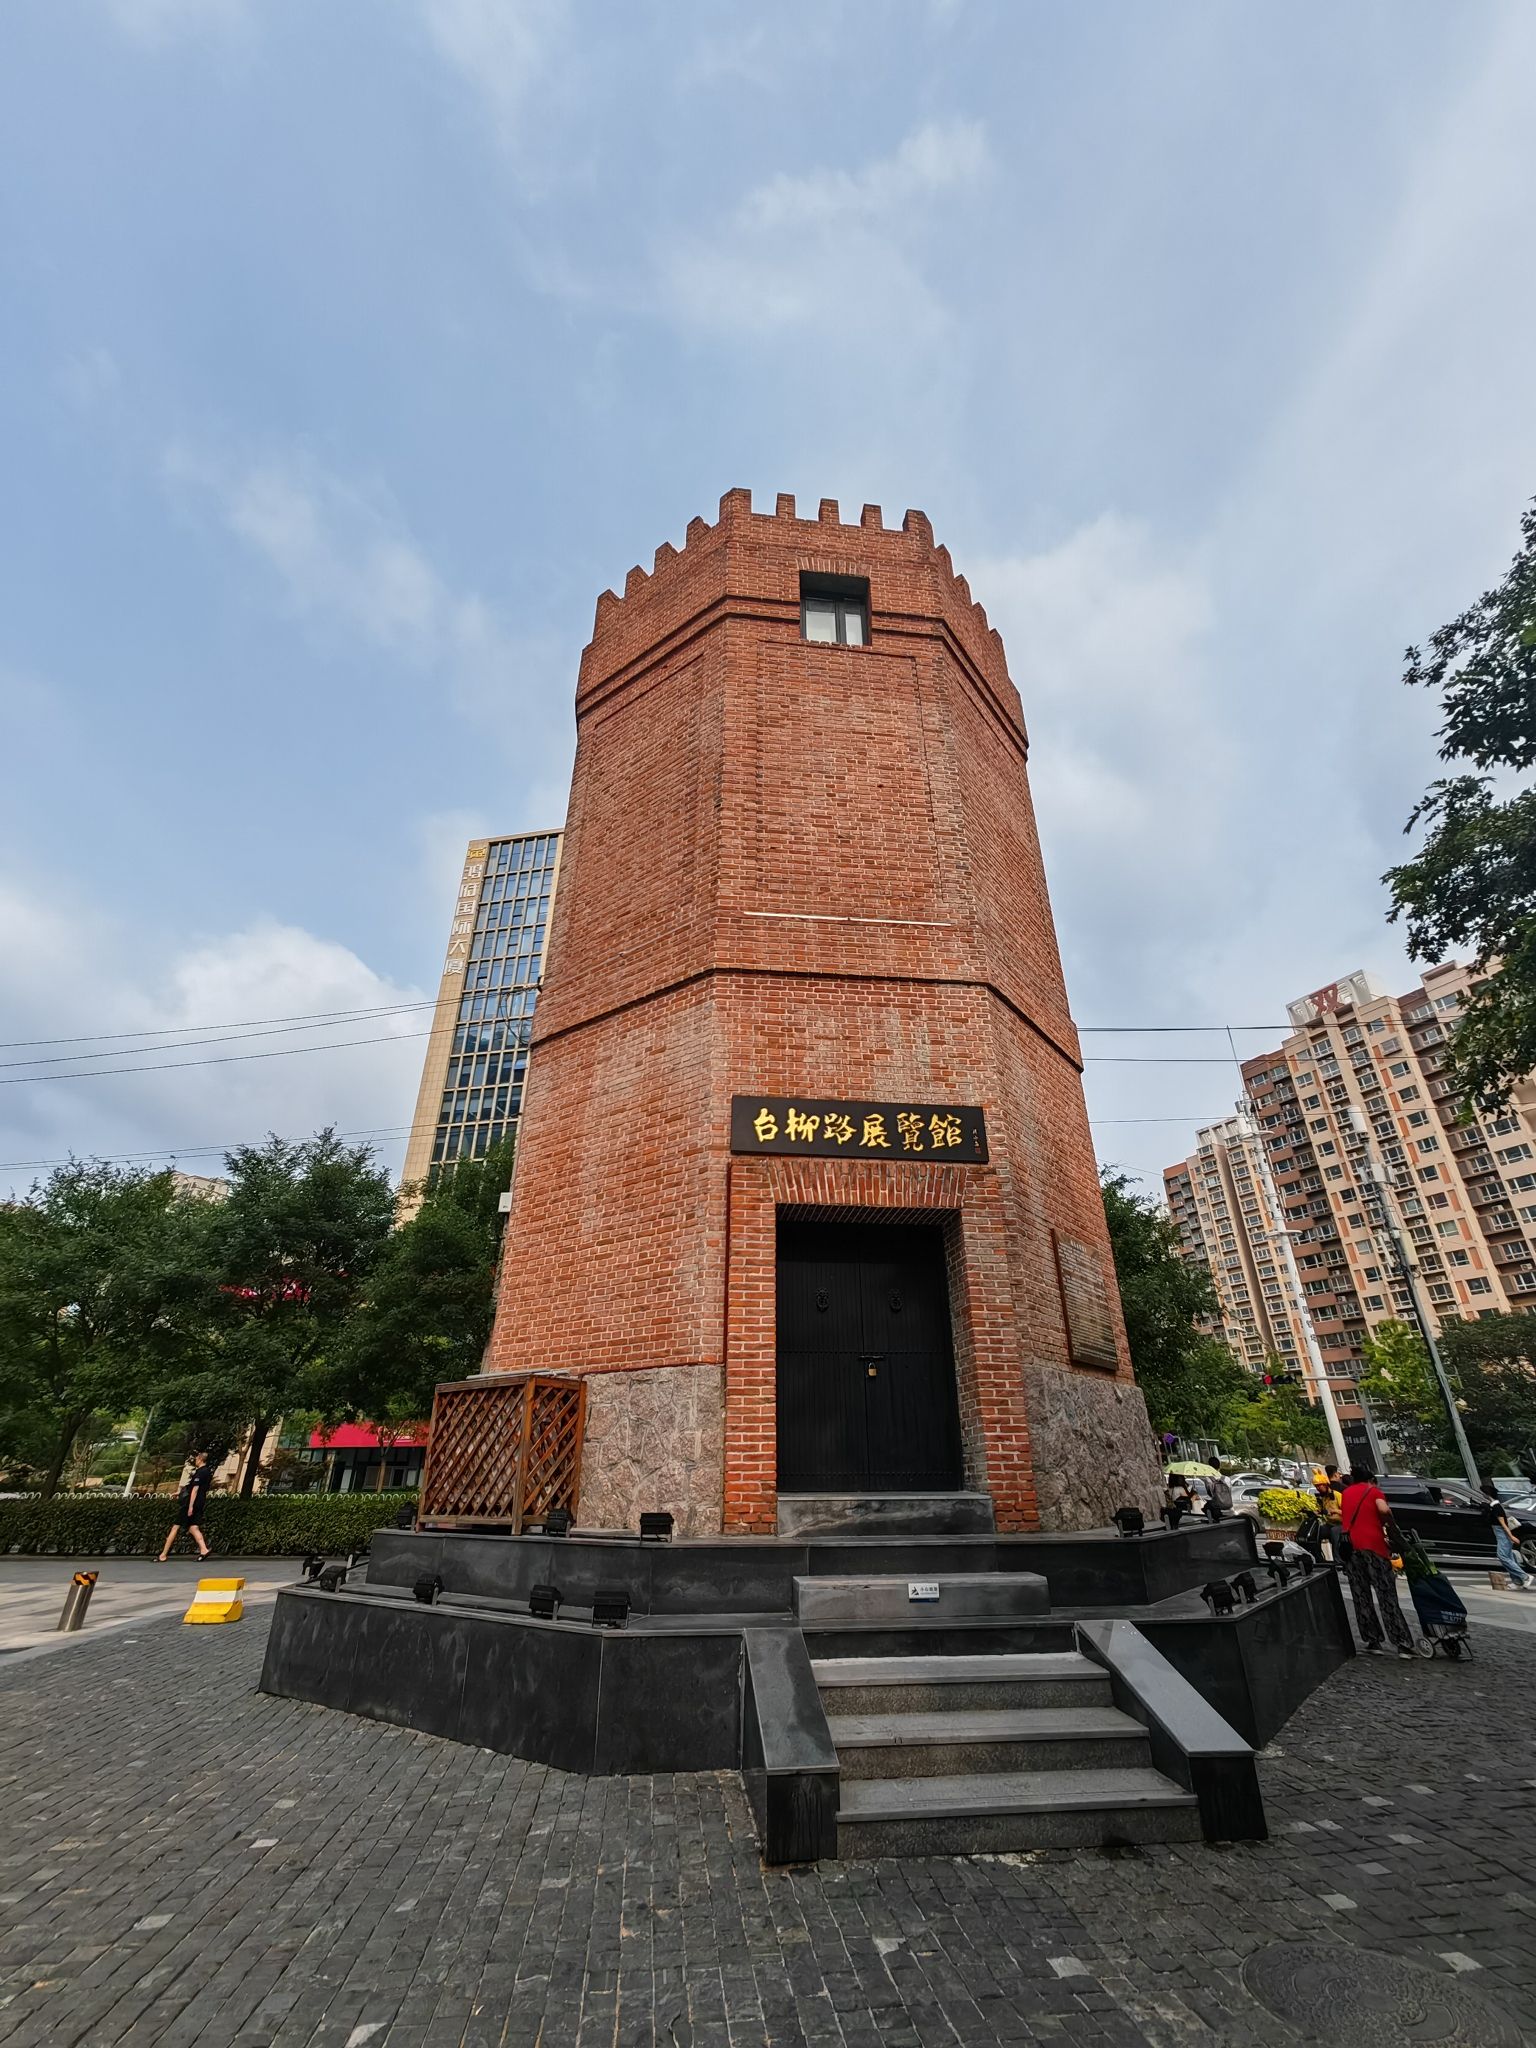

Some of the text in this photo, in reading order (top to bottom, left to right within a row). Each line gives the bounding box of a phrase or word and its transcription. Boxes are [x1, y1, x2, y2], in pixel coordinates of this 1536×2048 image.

[753, 1107, 962, 1152] 台柳路展覽館
